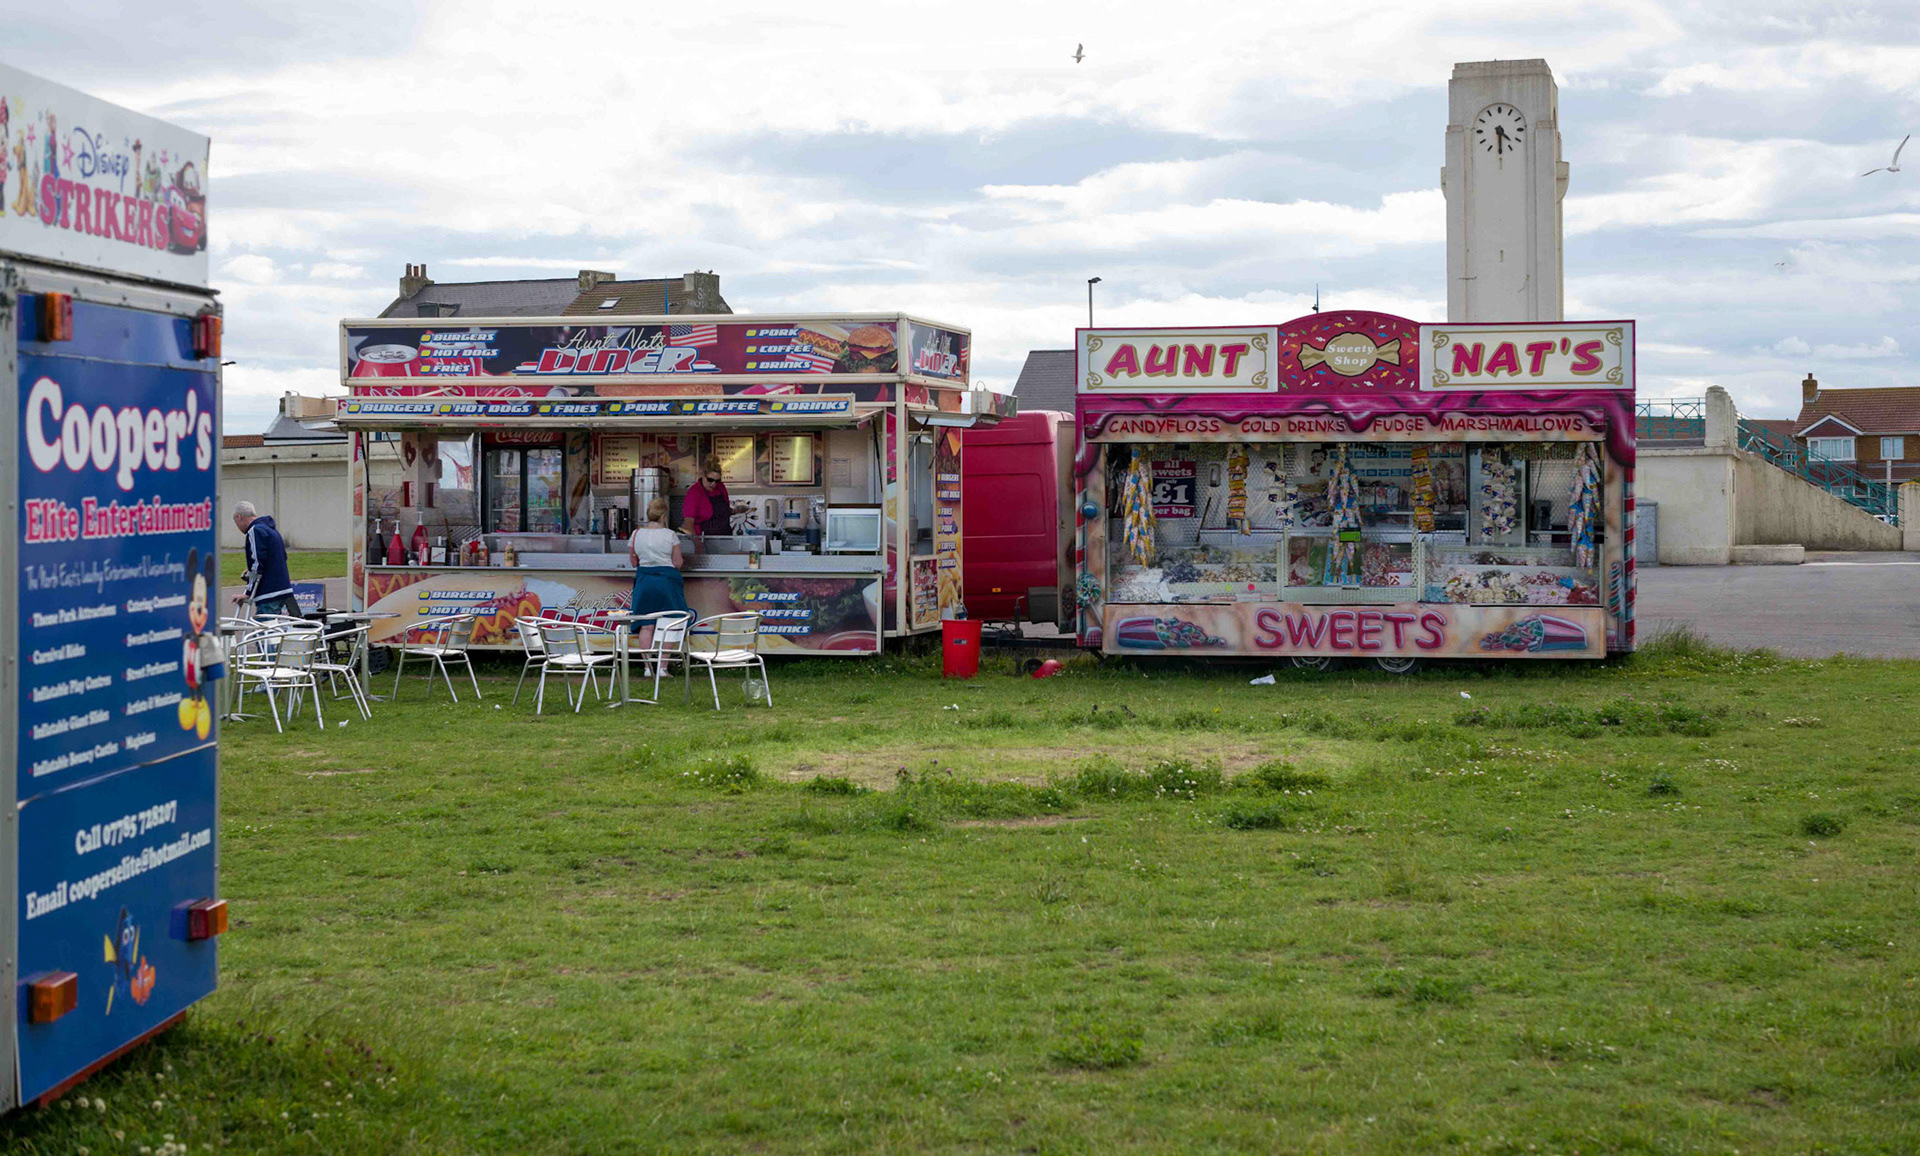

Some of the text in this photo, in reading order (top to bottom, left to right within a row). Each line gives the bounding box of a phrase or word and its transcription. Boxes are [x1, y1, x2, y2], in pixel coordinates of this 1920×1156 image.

[74, 127, 129, 192] Disney
[40, 174, 170, 251] STRIKERS
[432, 332, 495, 342] BURGERS
[758, 328, 800, 337] PORK
[557, 328, 616, 350] Aunt
[432, 348, 499, 358] HOT DOGS
[759, 344, 813, 353] COFFEE
[1327, 344, 1374, 355] Sweety
[536, 348, 697, 373] DINER
[919, 348, 958, 376] DINER
[1104, 343, 1251, 379] AUNT
[1334, 355, 1368, 367] Shop
[1451, 338, 1604, 378] NAT'S
[432, 364, 470, 373] FRIES
[758, 361, 812, 369] DRINKS
[362, 400, 849, 414] BURGERS HOT DOGS FRIES PORK COFFEE DRINKS
[1109, 417, 1583, 434] CANDYFLOSS COLD DRINKS FUDGE MARSHMALLOWS
[26, 376, 212, 490] Cooper's
[1164, 460, 1180, 468] all
[941, 474, 960, 482] BURGERS
[1153, 483, 1190, 504] £1
[941, 507, 953, 515] FRIES
[1171, 507, 1191, 516] bag
[25, 495, 212, 543] Elite Entertainment
[941, 524, 953, 532] PORK
[432, 591, 494, 599] BURGERS
[757, 593, 799, 601] PORK
[59, 608, 77, 623] Park
[431, 606, 498, 614] HOT DOGS
[758, 625, 810, 634] DRINKS
[1255, 609, 1447, 649] SWEETS
[75, 824, 102, 856] Call
[26, 828, 211, 920] Email cooperselite@hotmail.com
